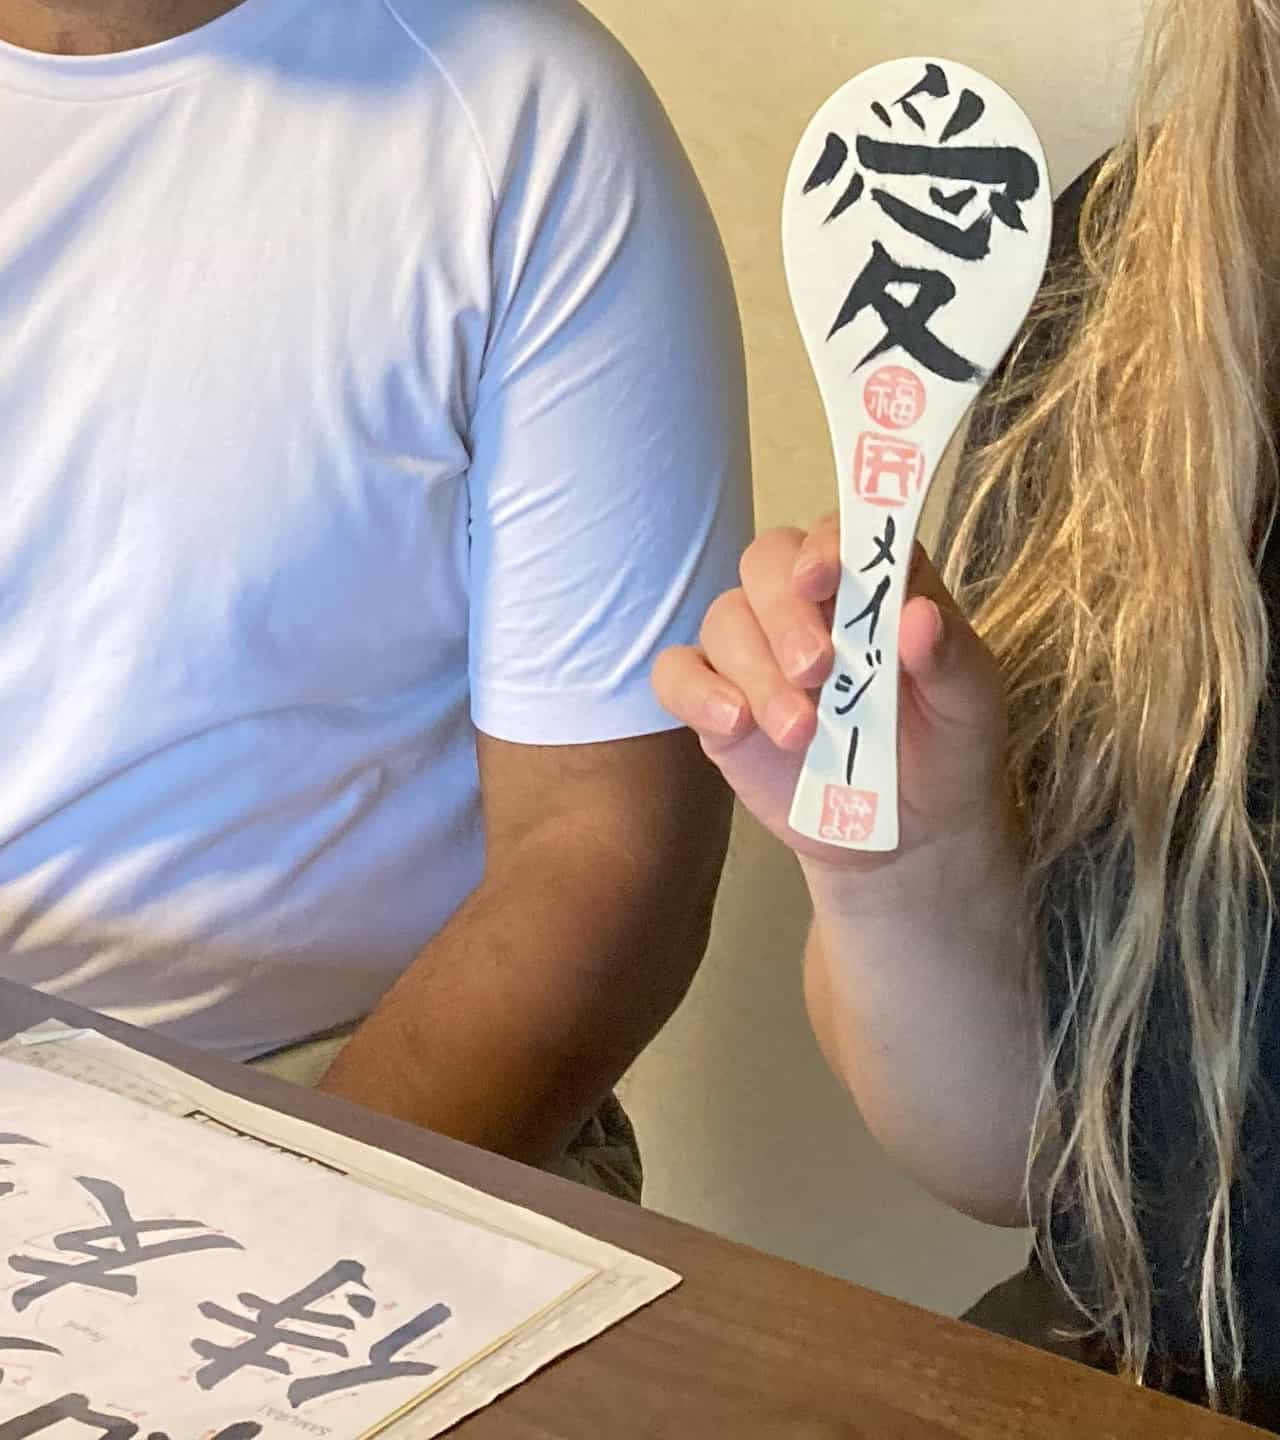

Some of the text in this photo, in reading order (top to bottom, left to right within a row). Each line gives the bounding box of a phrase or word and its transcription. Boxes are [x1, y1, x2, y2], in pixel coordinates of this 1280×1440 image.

[802, 63, 1041, 384] 愛
[864, 366, 926, 430] 福
[7, 1175, 247, 1314] 友
[189, 1258, 452, 1409] 侍
